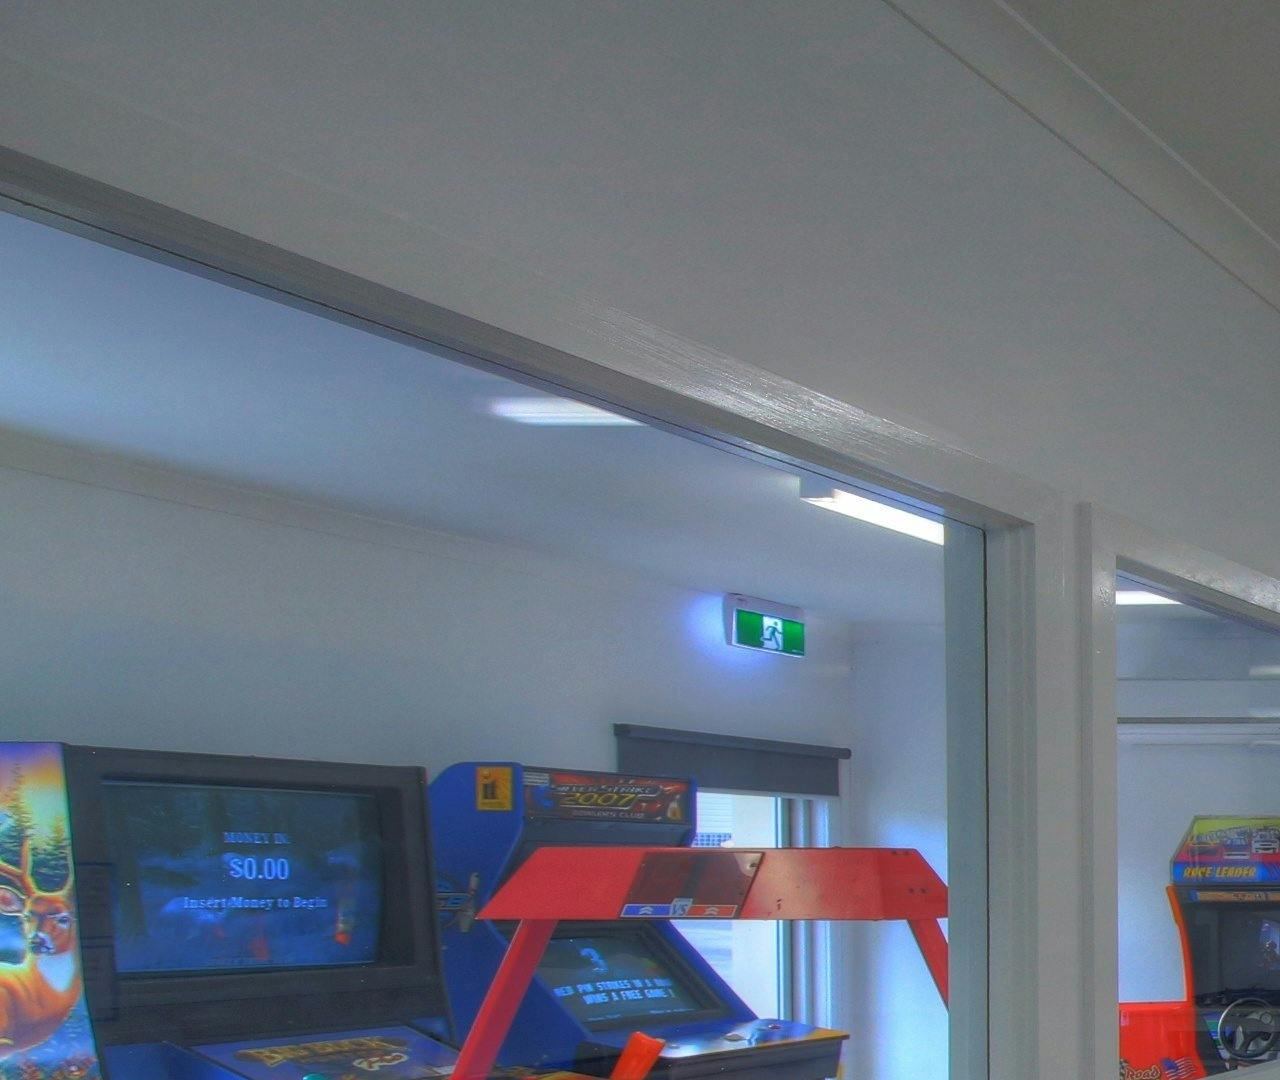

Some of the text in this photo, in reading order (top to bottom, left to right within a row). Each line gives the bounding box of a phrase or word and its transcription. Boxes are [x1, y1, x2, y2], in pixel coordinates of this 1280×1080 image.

[563, 793, 636, 806] 2007
[223, 832, 269, 844] MONEY
[229, 858, 289, 880] $0.00
[1184, 866, 1256, 878] RACE LEADER
[184, 897, 328, 910] Insert Money to Begin
[596, 980, 631, 991] STRIKES
[583, 993, 609, 1005] WINS
[620, 990, 643, 1001] FREE
[1125, 1064, 1160, 1080] Road
